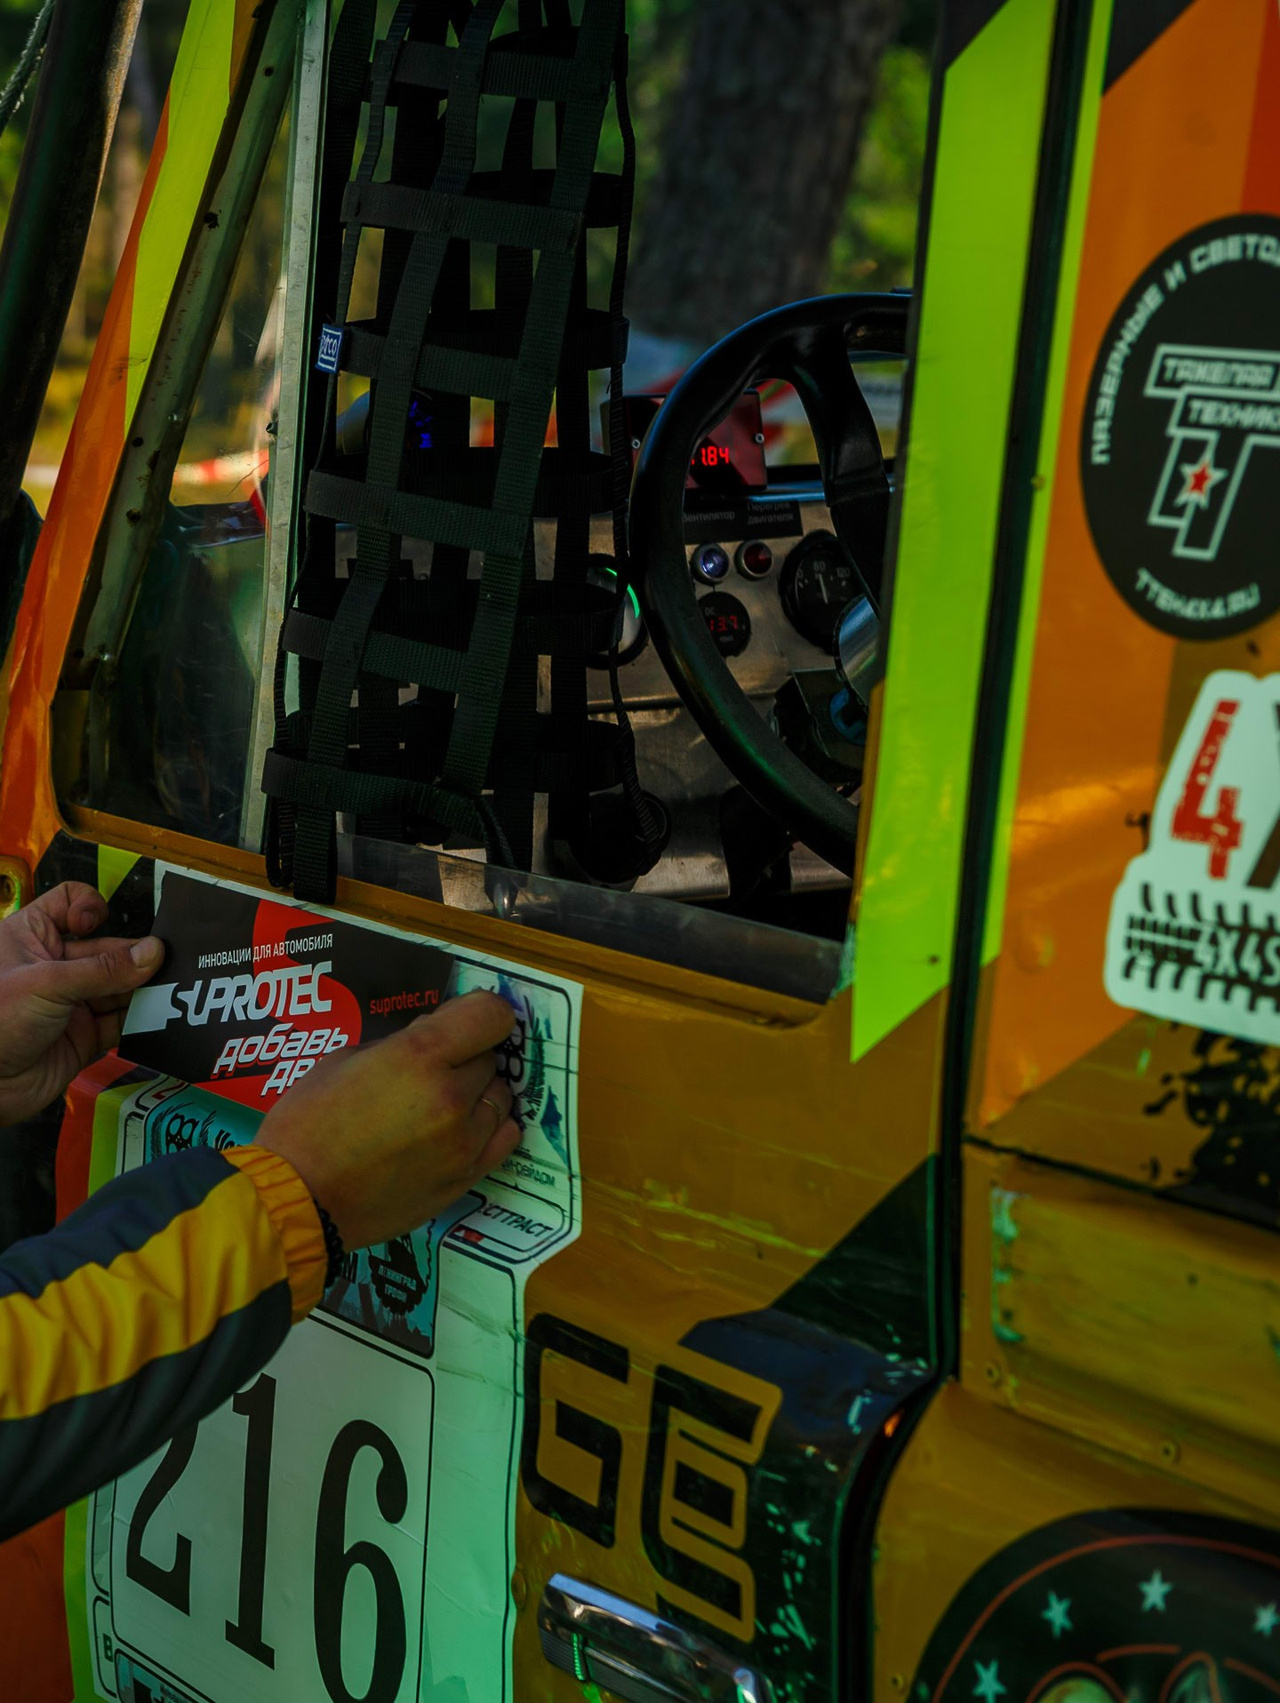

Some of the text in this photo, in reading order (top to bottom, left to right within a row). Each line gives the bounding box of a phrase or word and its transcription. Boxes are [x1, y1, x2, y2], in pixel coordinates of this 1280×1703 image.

[1163, 258, 1188, 290] И
[1189, 234, 1280, 275] СВЕТО
[198, 933, 333, 969] ИННОВАЦИИ ДЛЯ АВТОМОБИЛЯ
[122, 960, 333, 1035] SUPROTEC
[370, 988, 439, 1017] suprotec.ru
[214, 1022, 349, 1076] добавь
[260, 1057, 323, 1097] ДР
[478, 1203, 555, 1237] СТТРАСТ
[125, 1372, 410, 1703] 216
